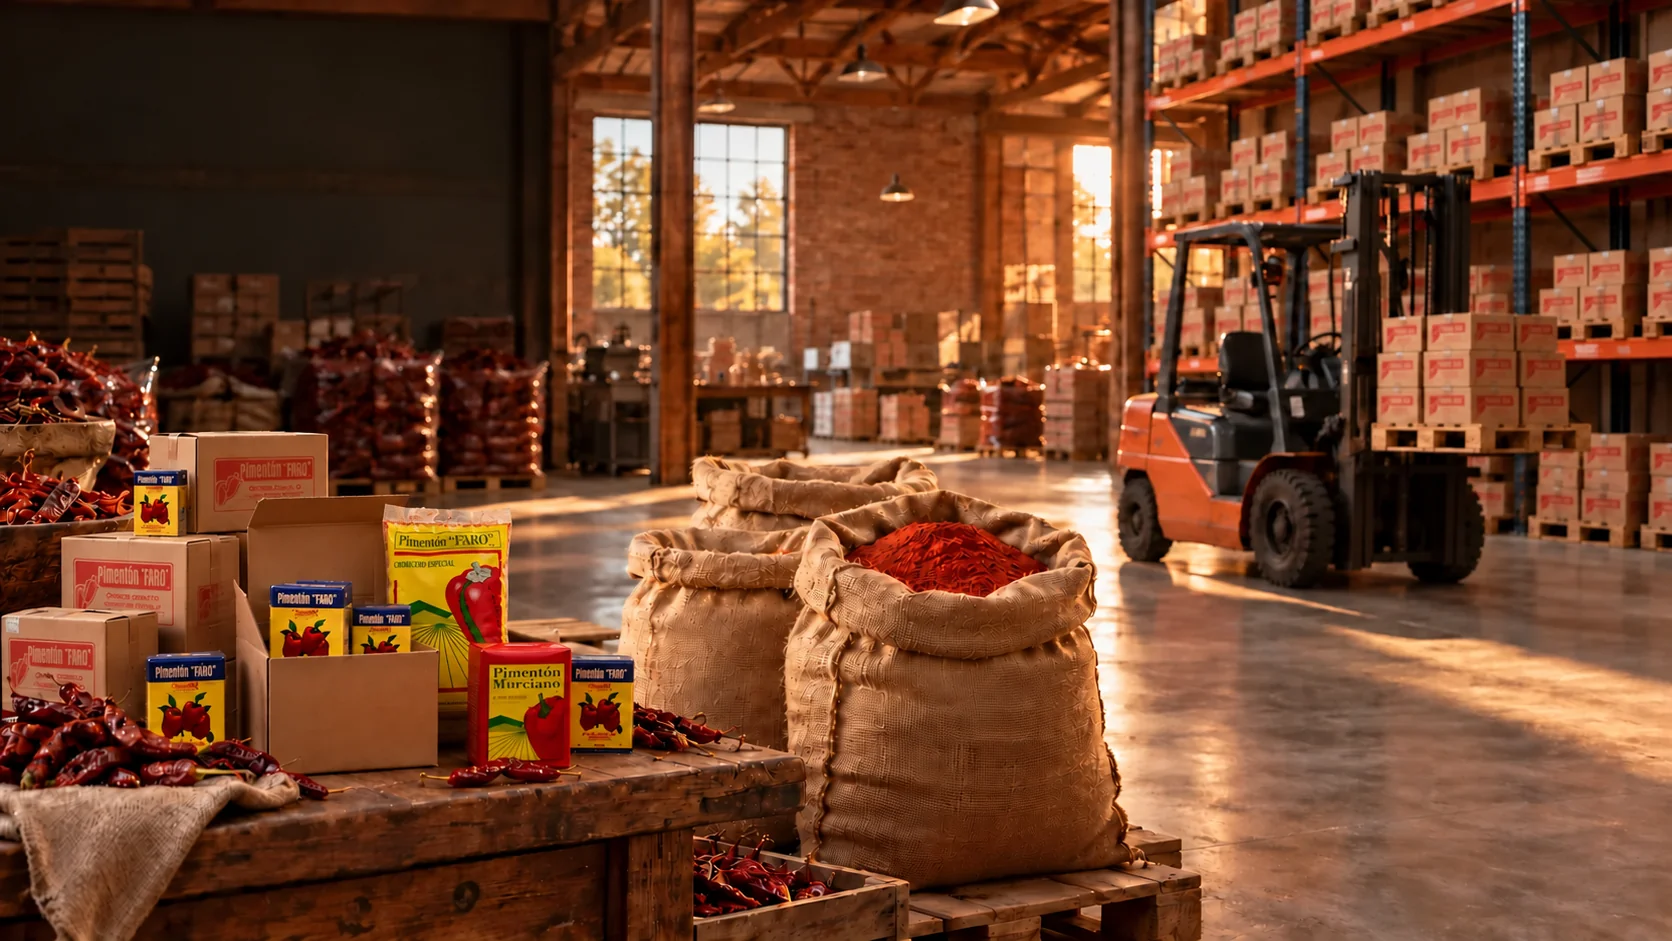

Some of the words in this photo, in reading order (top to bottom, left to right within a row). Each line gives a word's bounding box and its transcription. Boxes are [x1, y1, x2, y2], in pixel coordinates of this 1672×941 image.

[398, 534, 447, 548] Pimentón
[97, 565, 139, 585] Pimentón
[155, 664, 189, 679] Pimentón
[493, 666, 561, 678] Pimentón
[493, 679, 560, 690] Murciano
